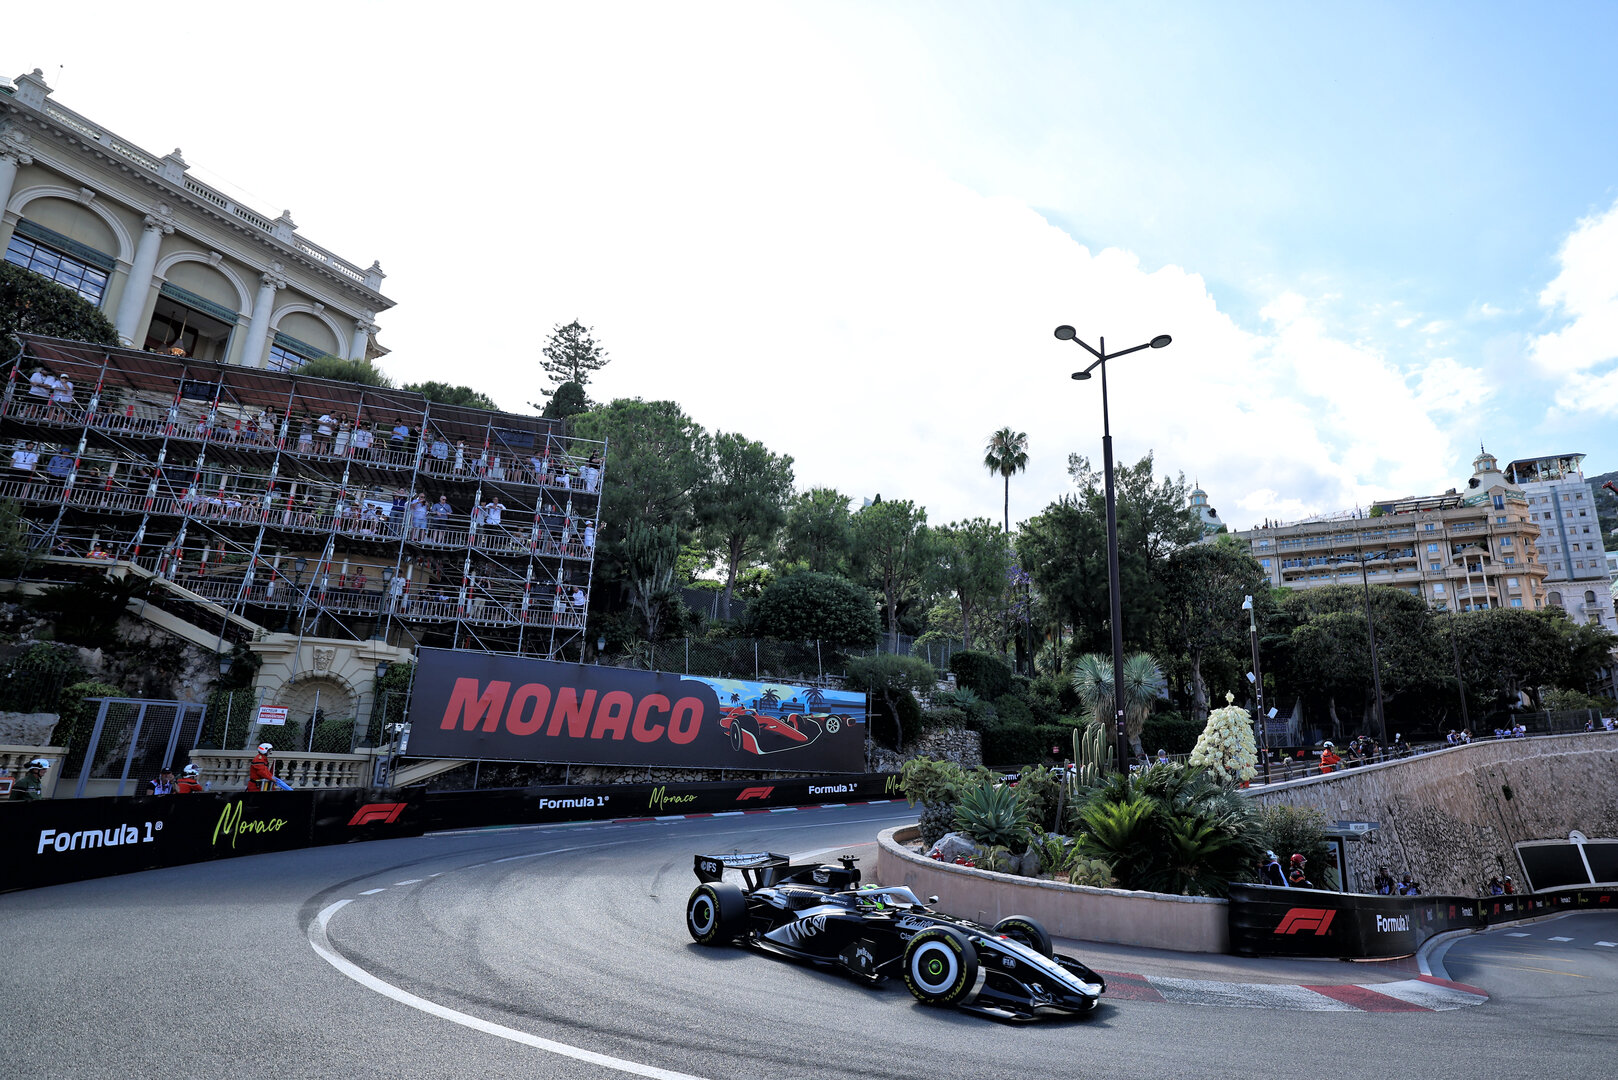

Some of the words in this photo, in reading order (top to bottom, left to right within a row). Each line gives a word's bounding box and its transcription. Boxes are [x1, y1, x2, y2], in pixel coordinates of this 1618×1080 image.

[440, 677, 704, 745] MONACO
[649, 785, 698, 811] Monaco
[736, 786, 776, 800] F1
[808, 784, 848, 795] Formula
[539, 797, 595, 809] Formula
[212, 800, 288, 848] Monaco
[347, 802, 408, 826] F1
[37, 823, 139, 854] Formula
[706, 861, 717, 873] IFS
[1273, 907, 1337, 936] F1
[1376, 914, 1405, 932] Formula
[1002, 957, 1016, 968] FIA
